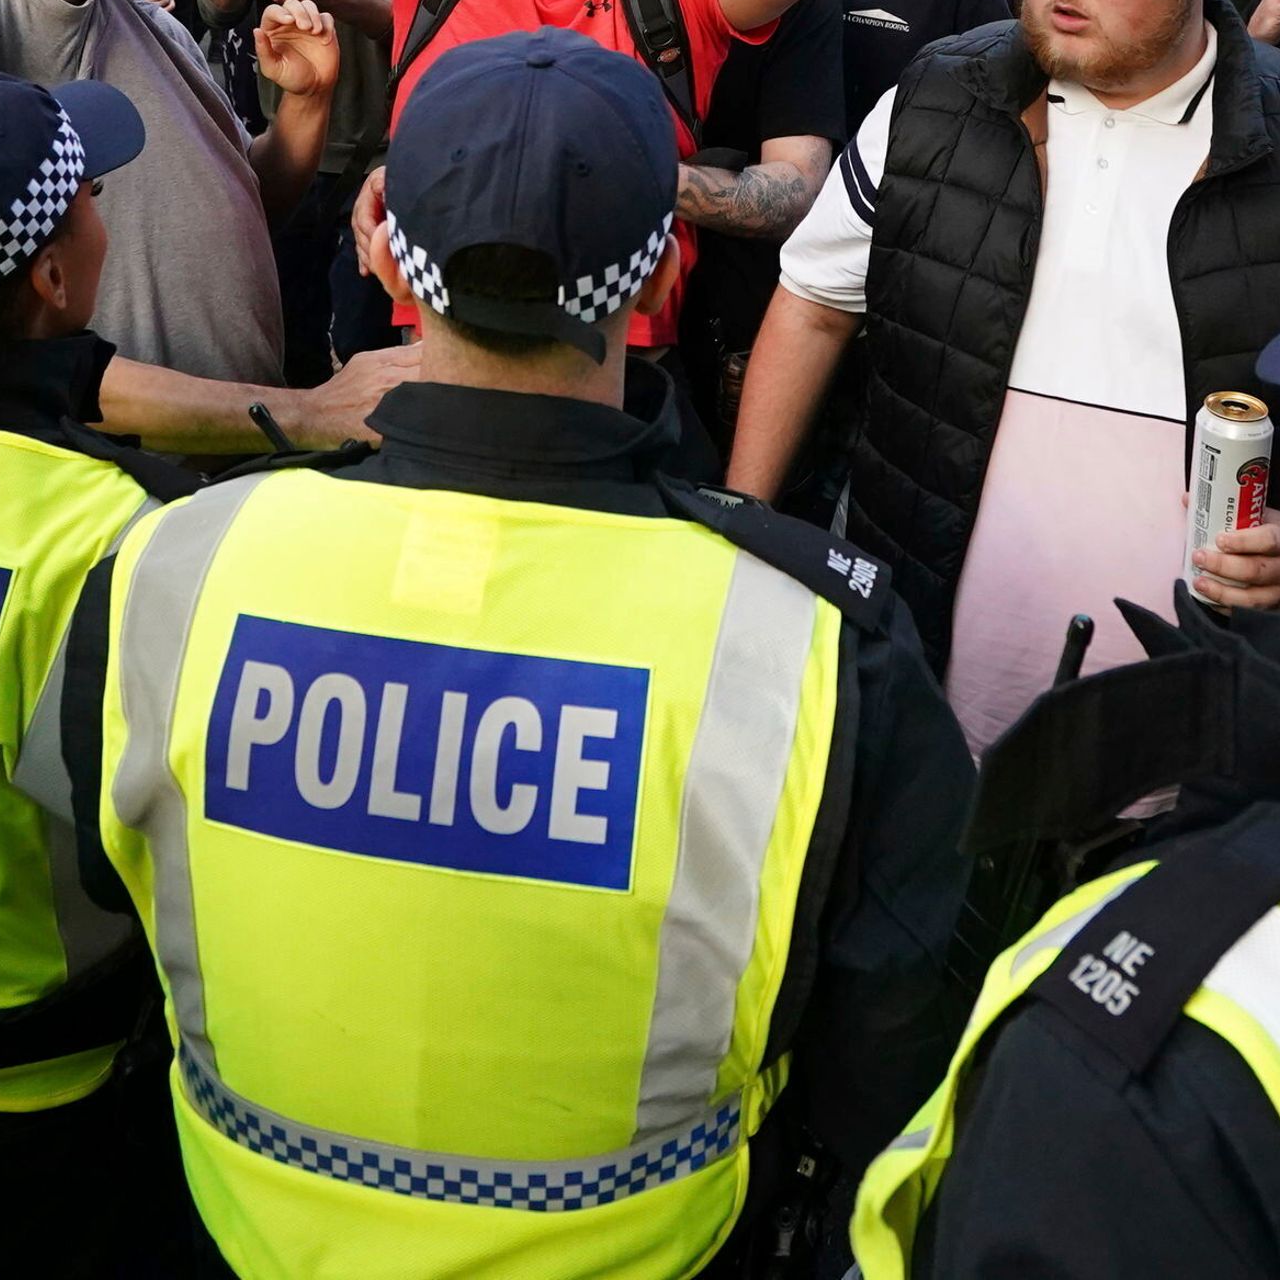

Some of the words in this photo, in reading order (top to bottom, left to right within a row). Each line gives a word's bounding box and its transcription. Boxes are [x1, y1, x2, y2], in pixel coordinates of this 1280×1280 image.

[1249, 483, 1264, 528] ARTO
[827, 548, 852, 576] NE
[848, 557, 878, 600] 2909
[225, 660, 618, 844] POLICE
[1102, 930, 1155, 978] NE
[1068, 953, 1141, 1016] 1205
